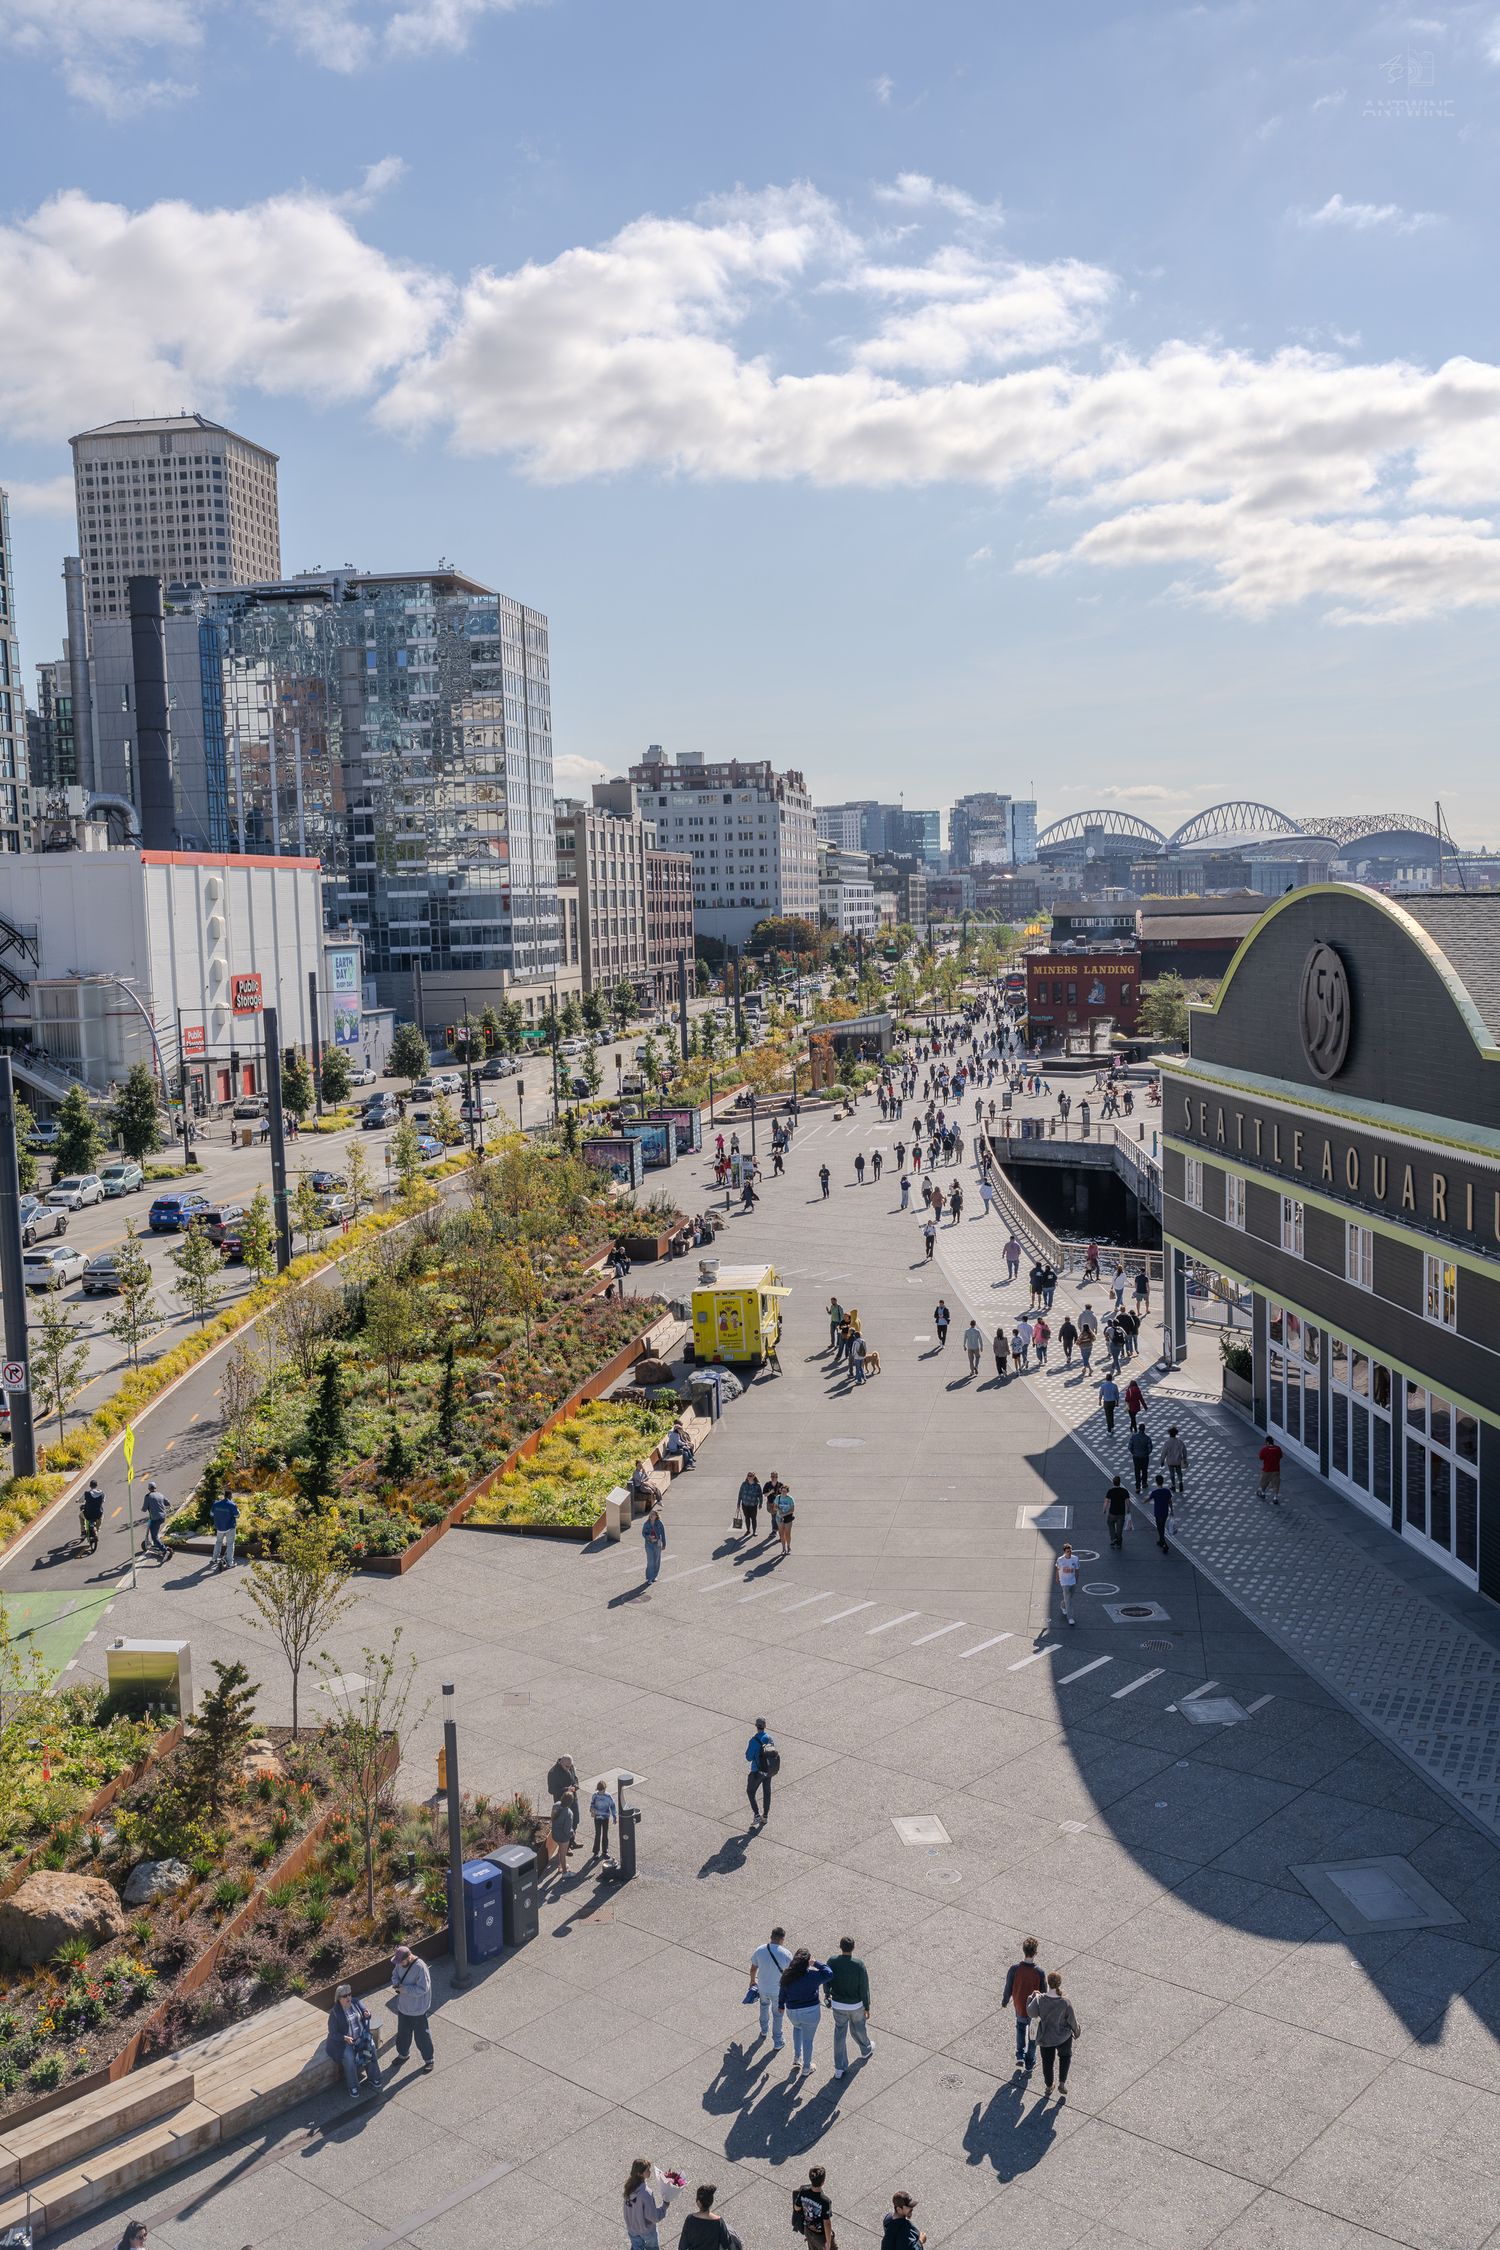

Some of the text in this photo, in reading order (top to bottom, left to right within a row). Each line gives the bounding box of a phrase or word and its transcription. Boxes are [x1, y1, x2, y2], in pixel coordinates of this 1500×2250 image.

[335, 956, 353, 968] EARTH
[335, 968, 348, 980] DAY
[1033, 965, 1135, 975] MINERS LANDING
[236, 980, 260, 993] Public
[236, 993, 262, 1009] Storage
[187, 1030, 203, 1040] Public
[1184, 1096, 1304, 1172] SEATTLE
